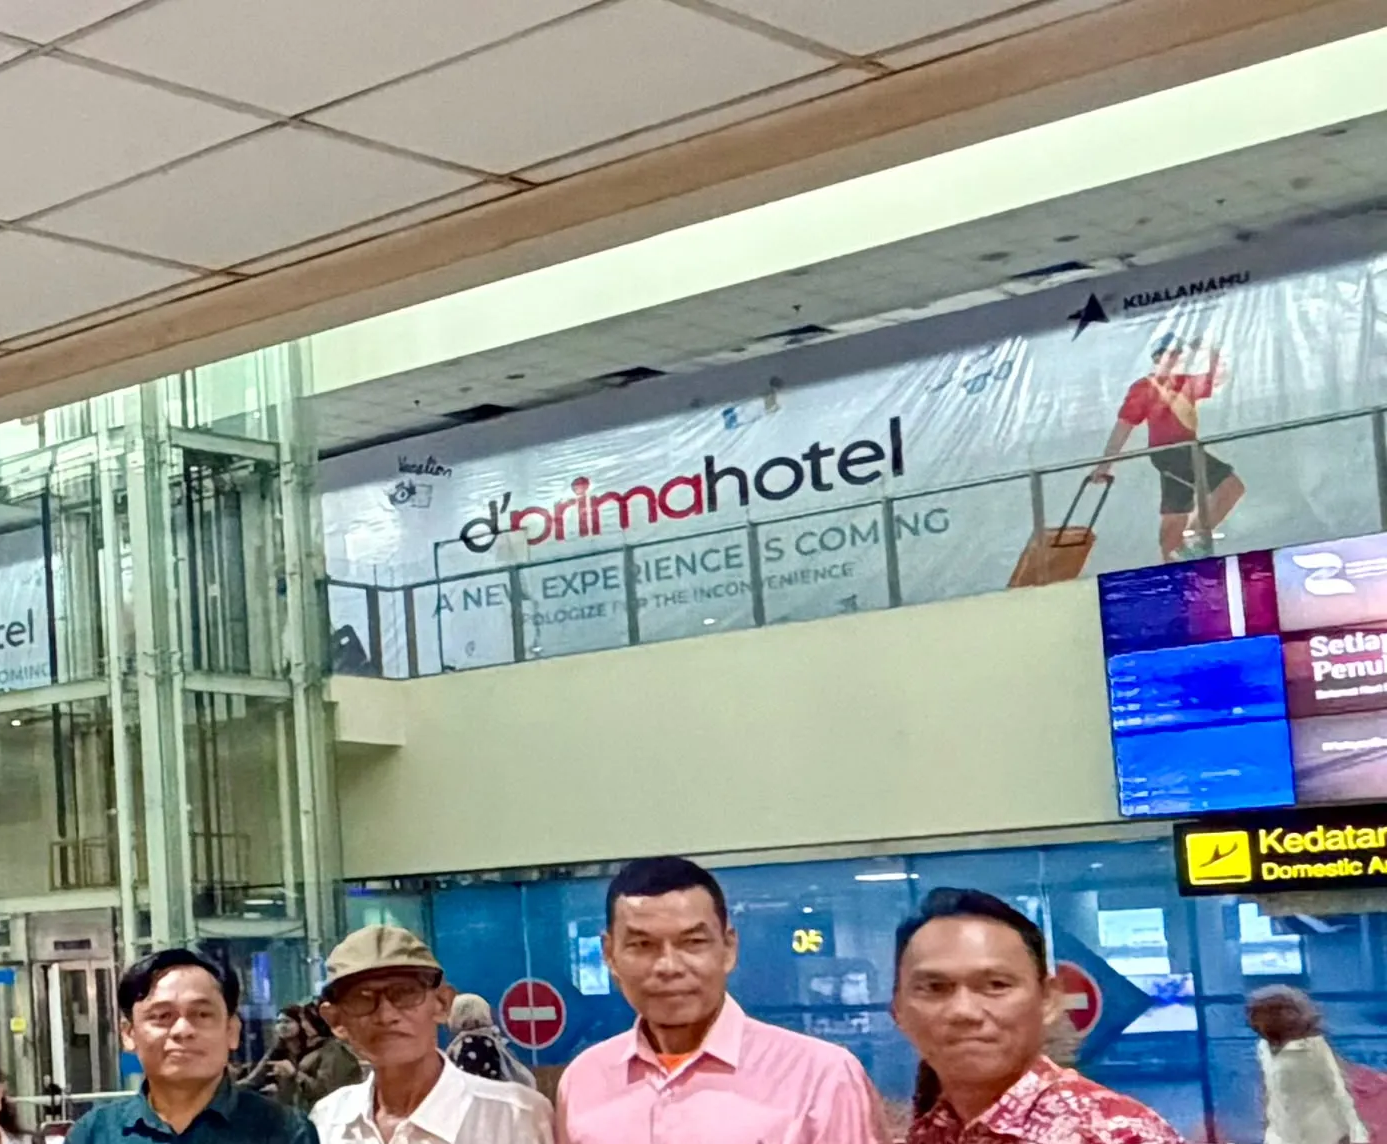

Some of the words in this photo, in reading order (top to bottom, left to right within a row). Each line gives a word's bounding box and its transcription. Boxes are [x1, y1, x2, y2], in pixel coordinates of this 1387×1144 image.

[1123, 270, 1251, 310] KUALANAMU
[459, 416, 904, 553] d'primahotel
[432, 593, 455, 618] A
[794, 507, 950, 556] COMNG
[1261, 858, 1363, 881] Domestic
